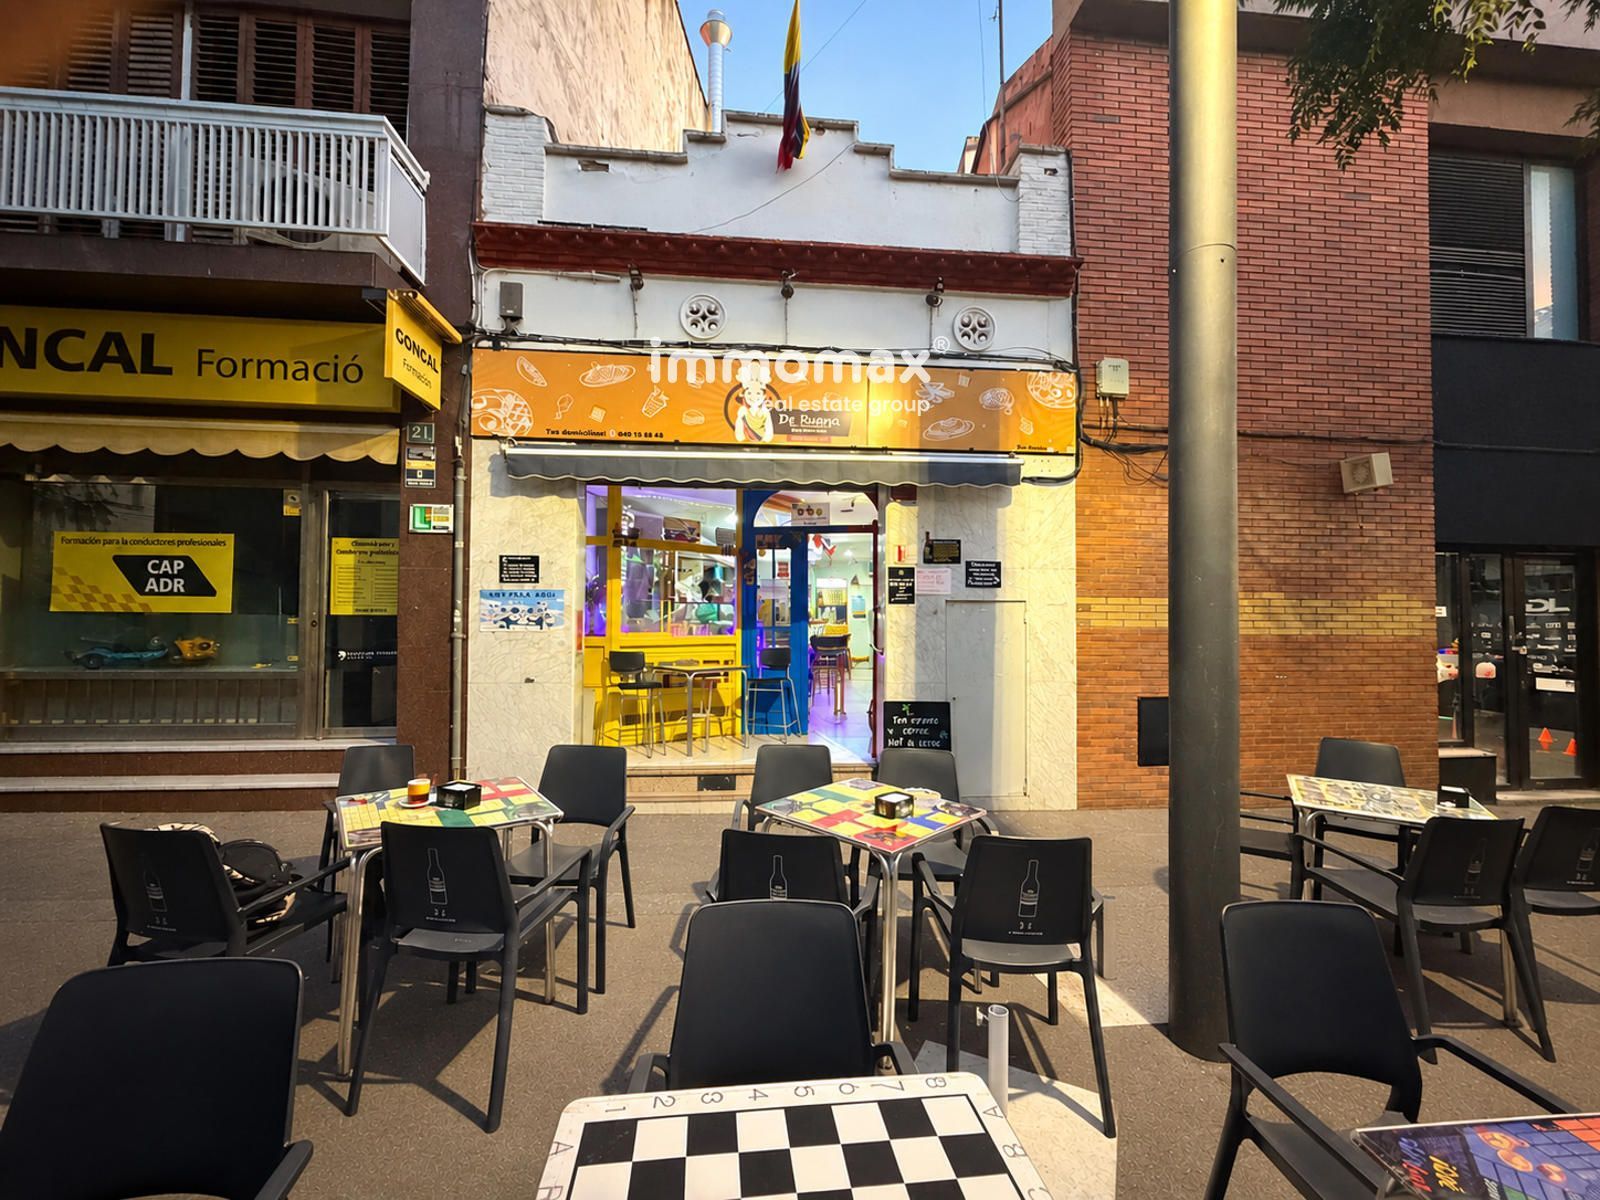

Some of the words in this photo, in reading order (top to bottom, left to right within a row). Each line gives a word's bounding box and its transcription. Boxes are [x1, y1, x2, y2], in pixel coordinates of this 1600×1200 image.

[395, 328, 439, 374] GONCAL
[196, 348, 364, 384] Formació
[102, 537, 121, 547] para
[129, 537, 176, 547] conductores
[177, 537, 227, 548] profesionales
[147, 559, 185, 575] CAP
[144, 578, 186, 593] ADR
[652, 1095, 676, 1109] 2
[701, 1091, 724, 1104] 3
[748, 1088, 769, 1101] 4
[794, 1085, 815, 1097] 5
[839, 1083, 860, 1095] 6
[871, 1080, 905, 1092] 7
[925, 1076, 947, 1089] 8
[982, 1106, 1004, 1119] A
[550, 1141, 574, 1156] A
